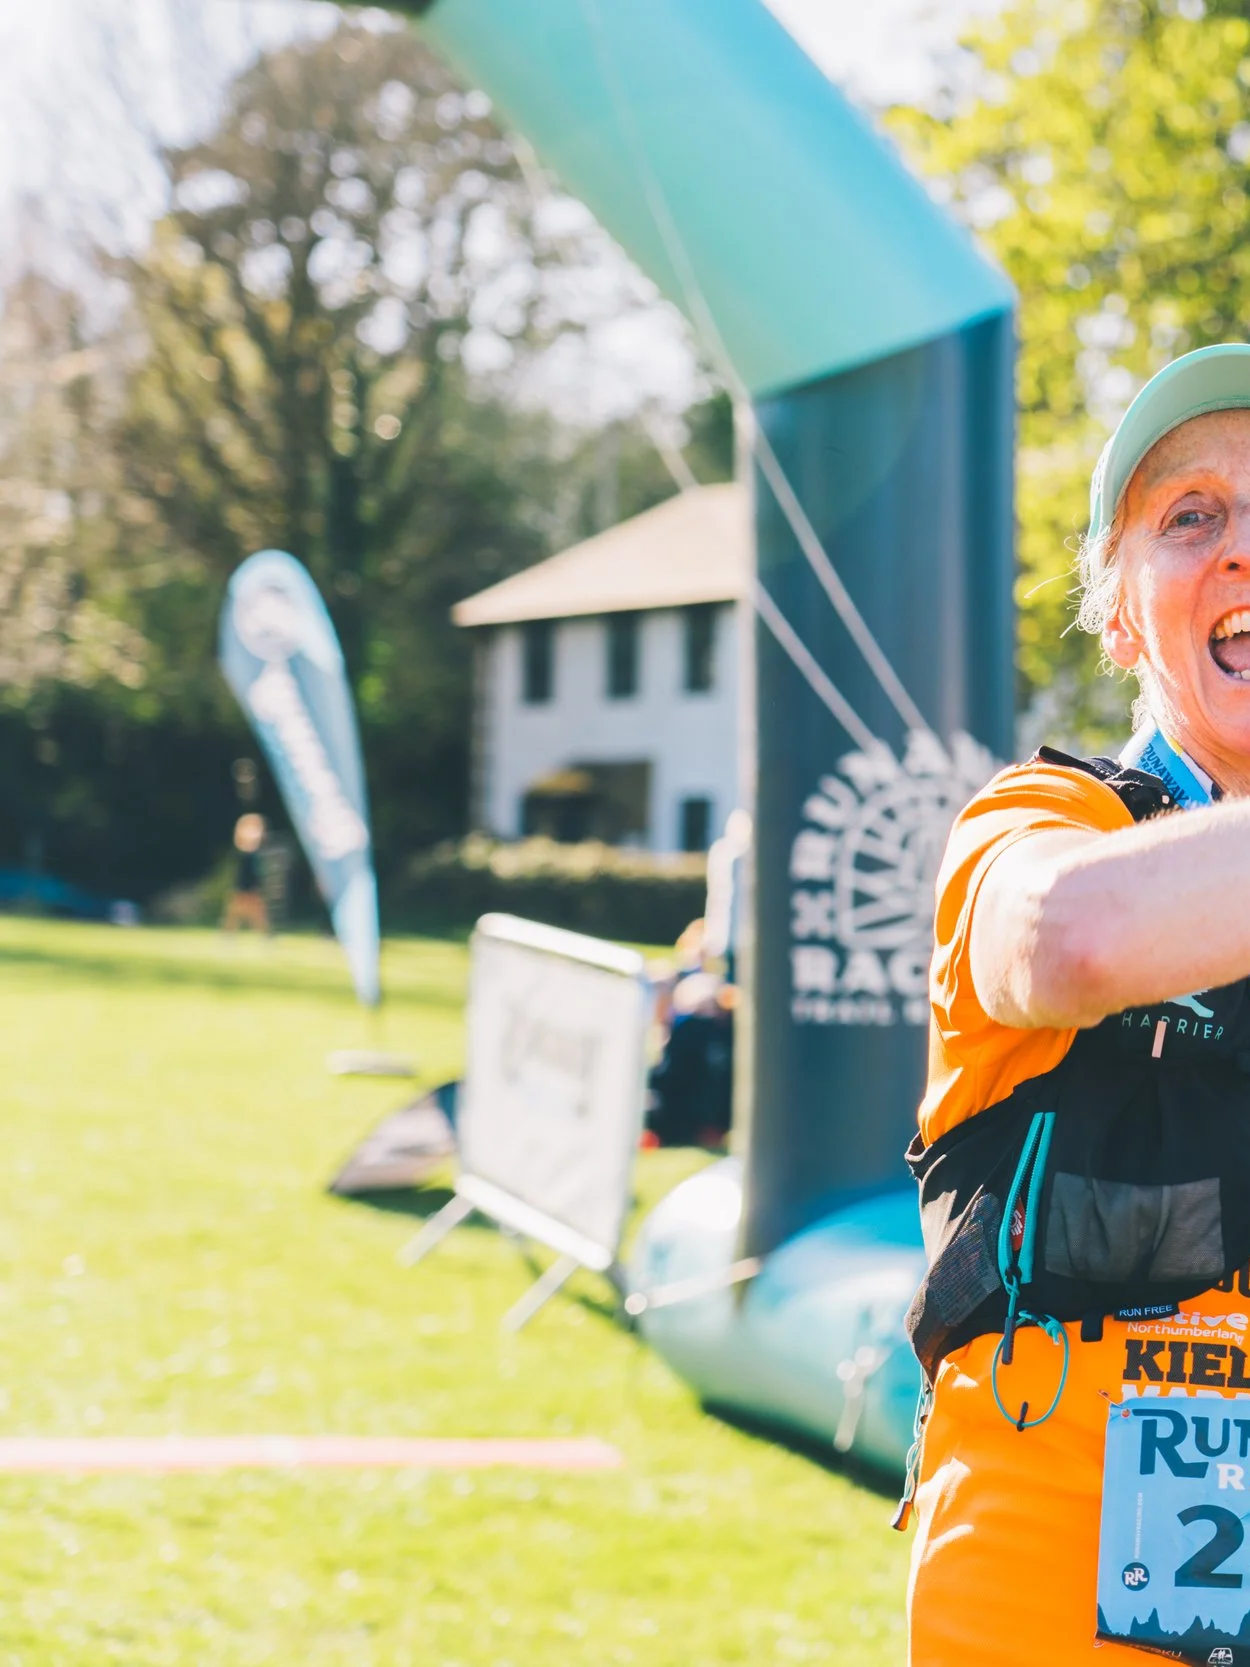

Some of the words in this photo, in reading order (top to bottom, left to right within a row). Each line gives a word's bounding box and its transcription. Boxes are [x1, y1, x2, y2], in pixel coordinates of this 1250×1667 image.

[1119, 1307, 1142, 1317] RUN
[1144, 1304, 1172, 1314] FREE
[1158, 1311, 1249, 1331] tive
